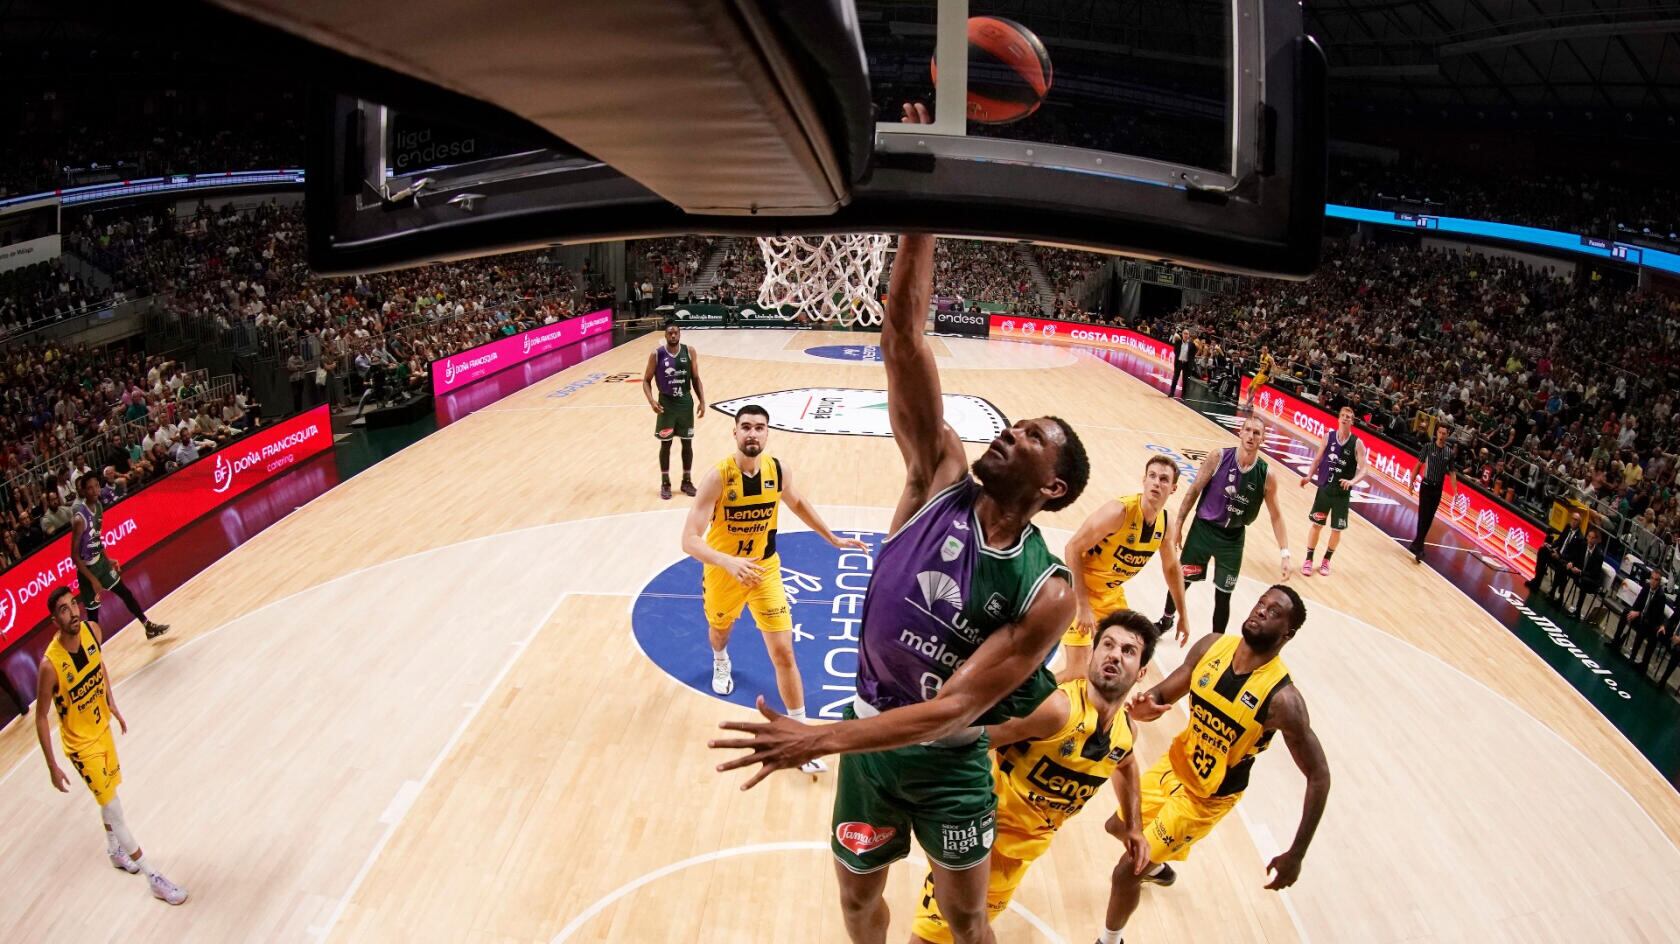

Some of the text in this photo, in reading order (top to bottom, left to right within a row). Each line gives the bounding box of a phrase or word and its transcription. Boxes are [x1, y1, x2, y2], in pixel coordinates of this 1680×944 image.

[397, 138, 475, 168] endesa
[937, 312, 984, 325] endesa
[1071, 329, 1108, 343] COSTA
[1111, 334, 1129, 345] DEL
[455, 361, 469, 374] DOÑA
[672, 386, 684, 397] 34
[1293, 411, 1325, 437] COSTA
[234, 425, 319, 474] DOÑA FRANCISQUITA
[267, 454, 294, 472] catering
[726, 507, 773, 521] Lenovo
[736, 539, 754, 555] 14
[18, 568, 57, 604] DOÑA
[71, 669, 103, 701] Lenovo
[93, 705, 101, 725] 3
[1192, 745, 1217, 780] 23
